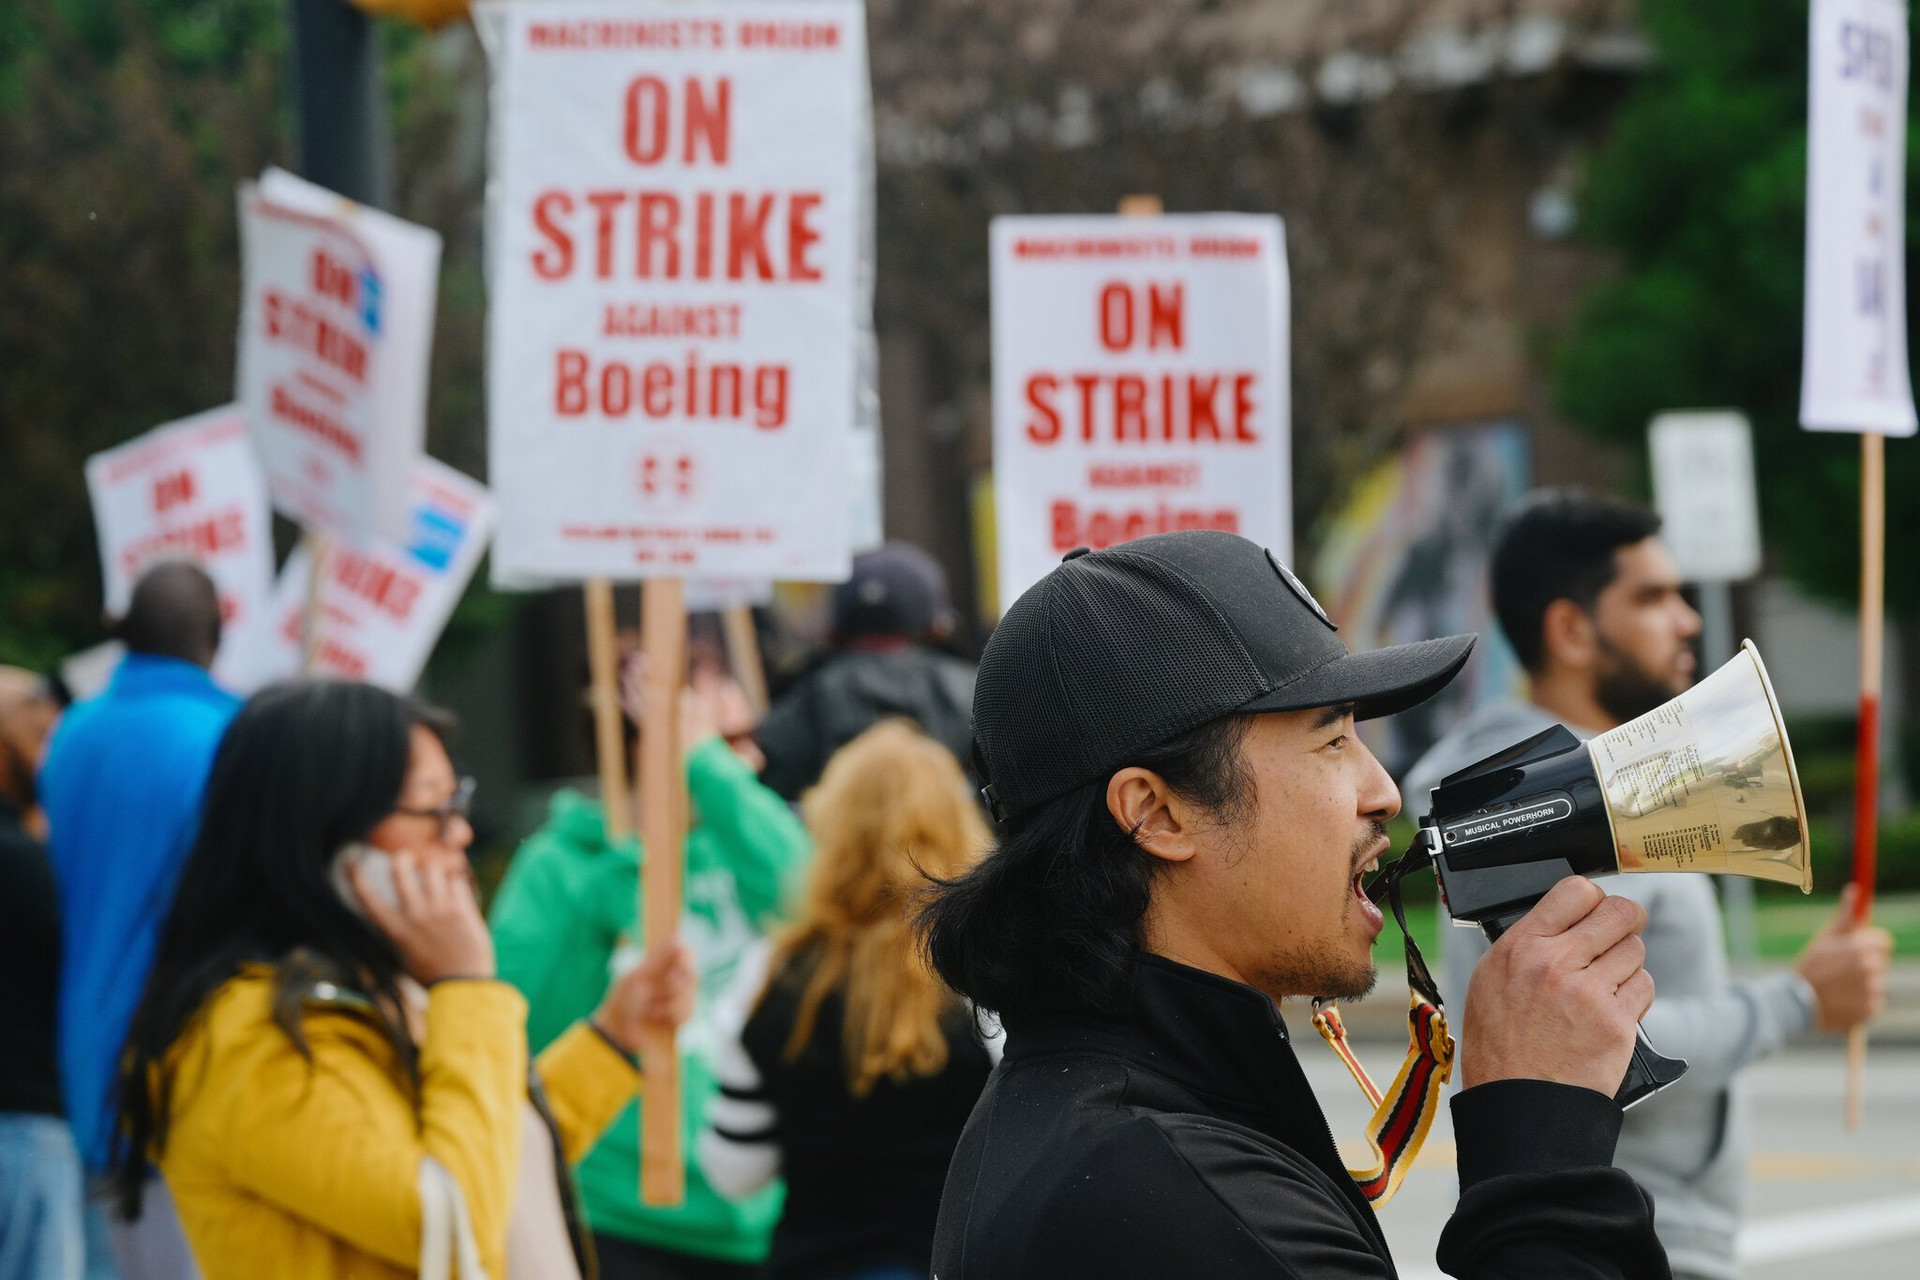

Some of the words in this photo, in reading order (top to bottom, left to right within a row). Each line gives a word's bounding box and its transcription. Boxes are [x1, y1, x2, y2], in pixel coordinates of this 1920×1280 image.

[622, 73, 733, 168] ON
[530, 188, 824, 283] STRIKE
[601, 303, 743, 339] AGAINST
[1098, 279, 1185, 353] ON
[553, 348, 791, 432] Boeing
[1024, 372, 1260, 446] STRIKE
[1464, 821, 1501, 837] MUSICAL
[1502, 808, 1555, 827] POWERHORN
